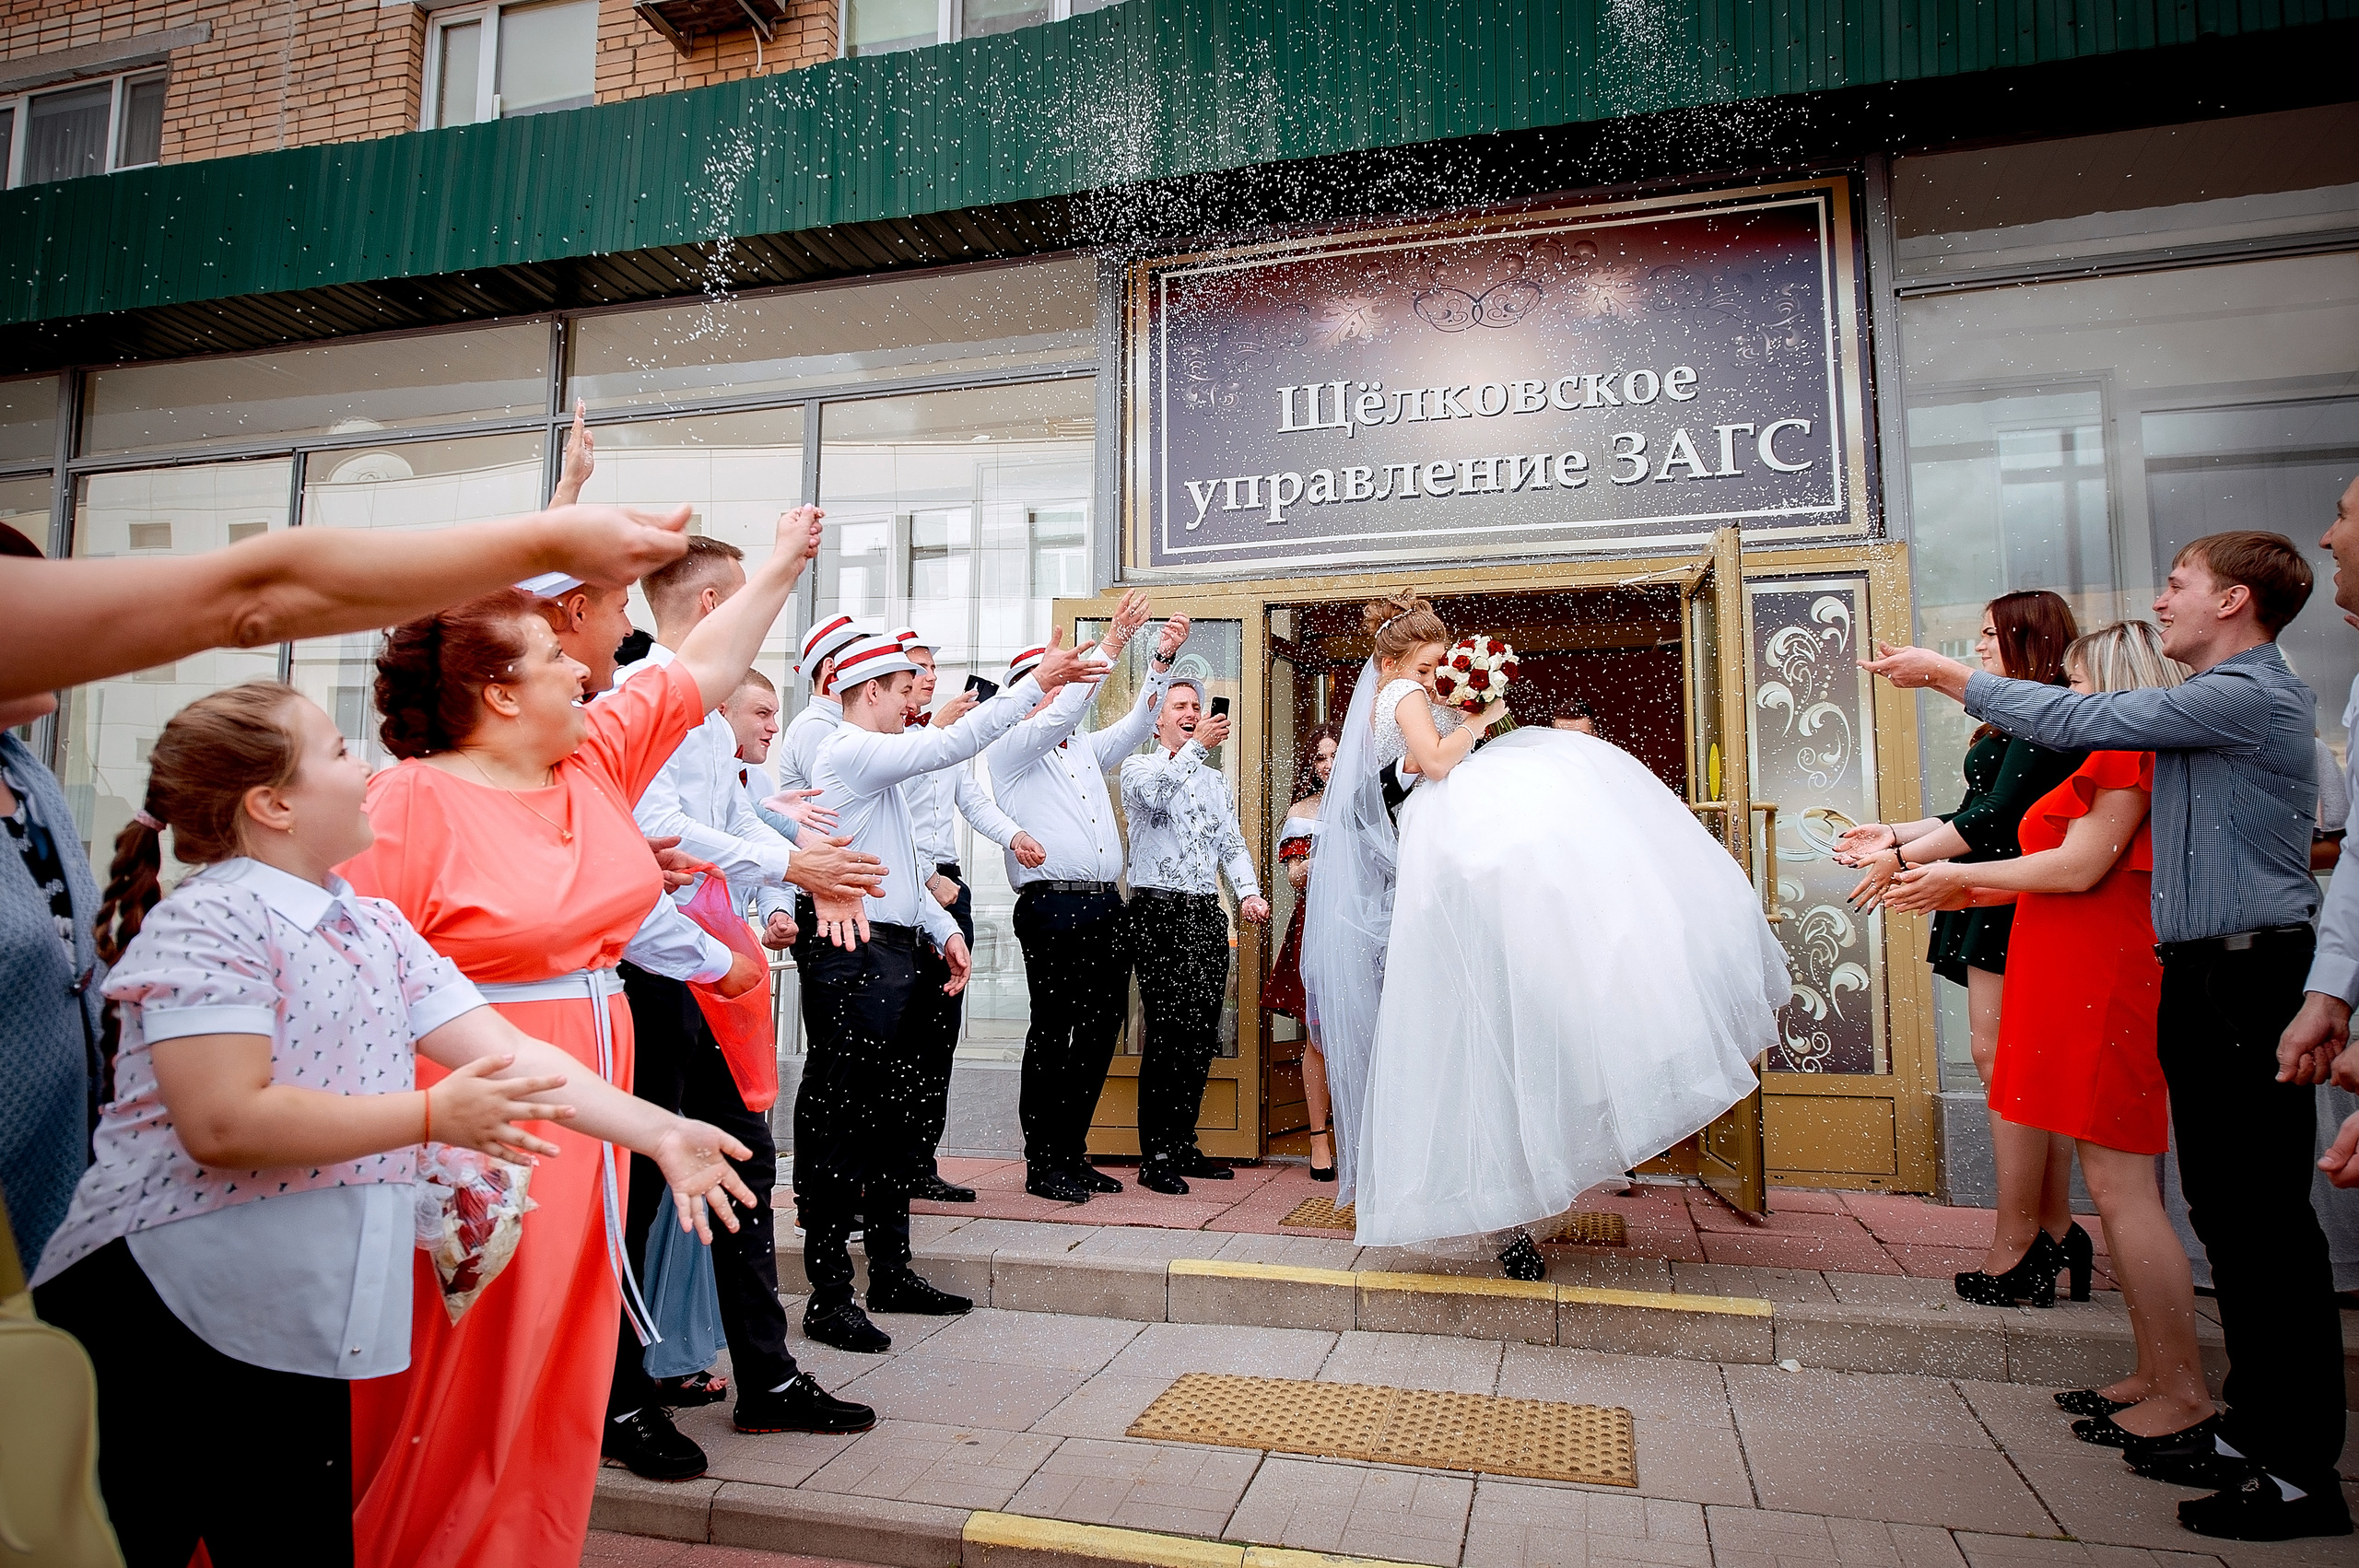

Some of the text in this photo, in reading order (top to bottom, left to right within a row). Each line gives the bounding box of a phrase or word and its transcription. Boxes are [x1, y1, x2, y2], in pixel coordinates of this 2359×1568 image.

[1276, 366, 1698, 438] Щёлковское
[1184, 418, 1813, 531] управление ЗАГС
